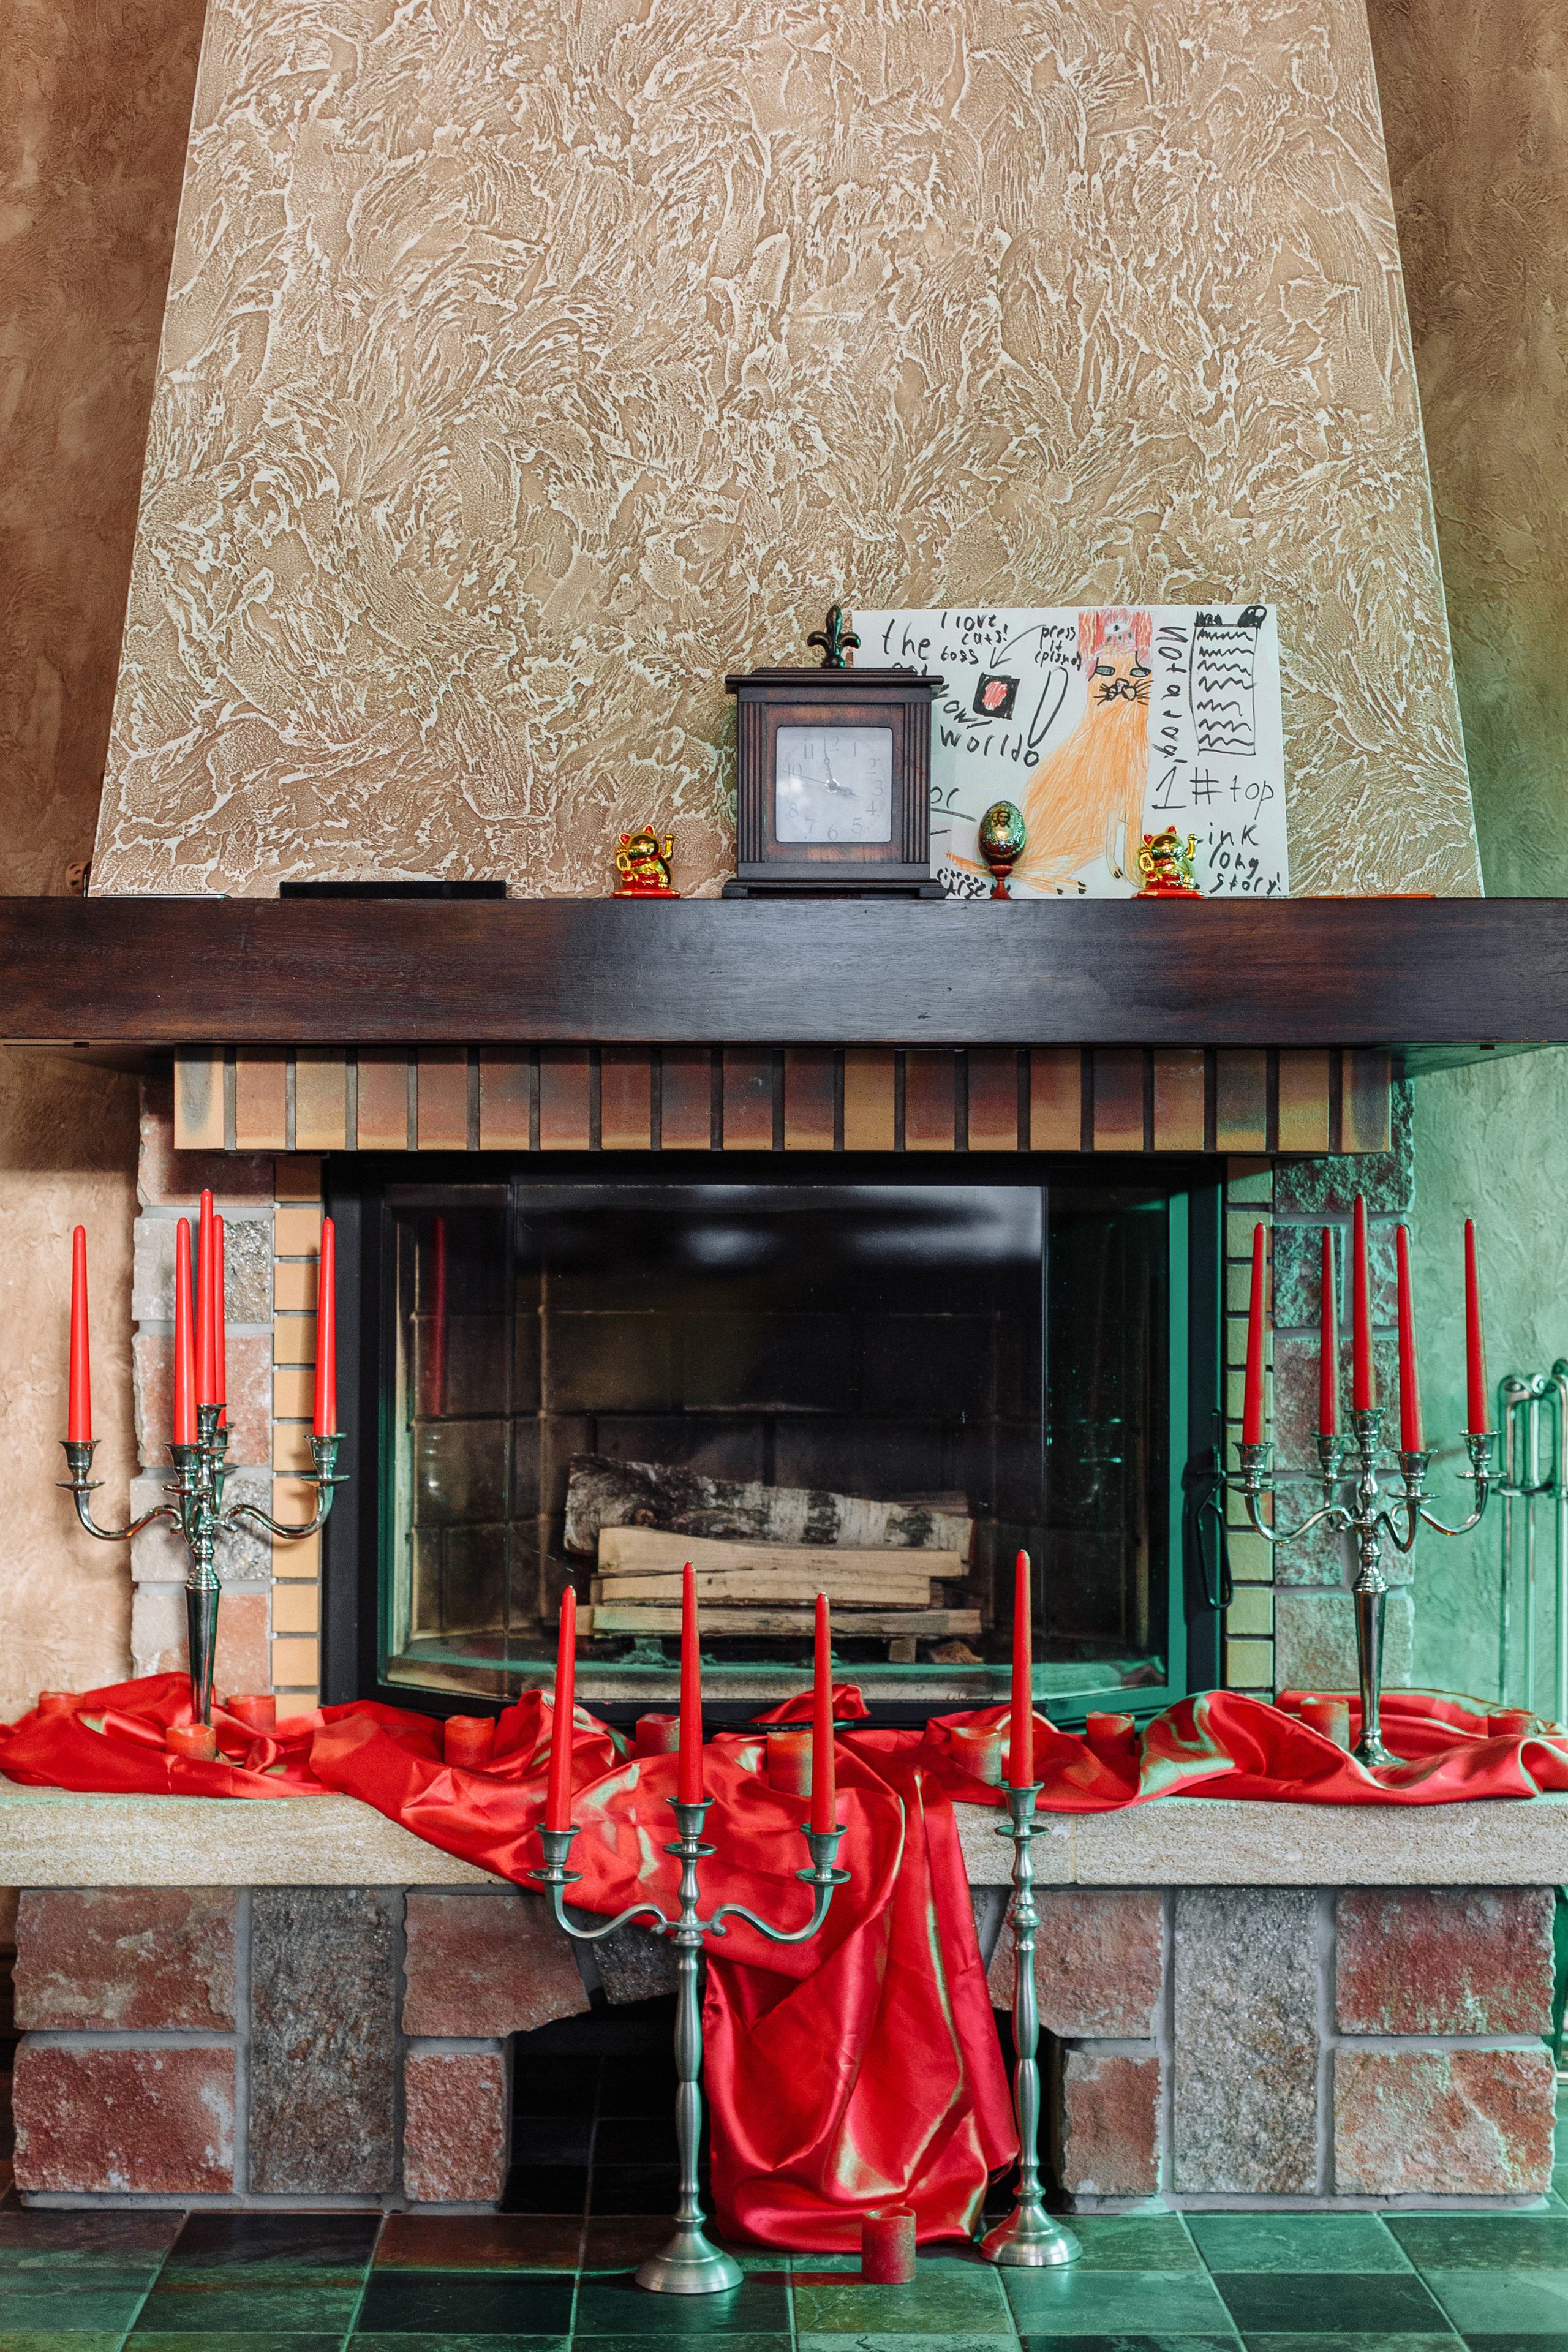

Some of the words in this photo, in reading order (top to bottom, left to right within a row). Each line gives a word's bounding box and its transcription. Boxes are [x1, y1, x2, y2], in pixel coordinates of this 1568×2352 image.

[956, 614, 997, 632] love
[881, 619, 931, 660] the
[961, 624, 1008, 646] cats!
[865, 758, 877, 775] 2
[872, 780, 883, 797] 3
[1229, 775, 1274, 820] top
[788, 802, 799, 818] 8
[865, 799, 878, 816] 4
[805, 818, 816, 834] 7
[827, 823, 839, 841] 6
[851, 817, 862, 834] 5
